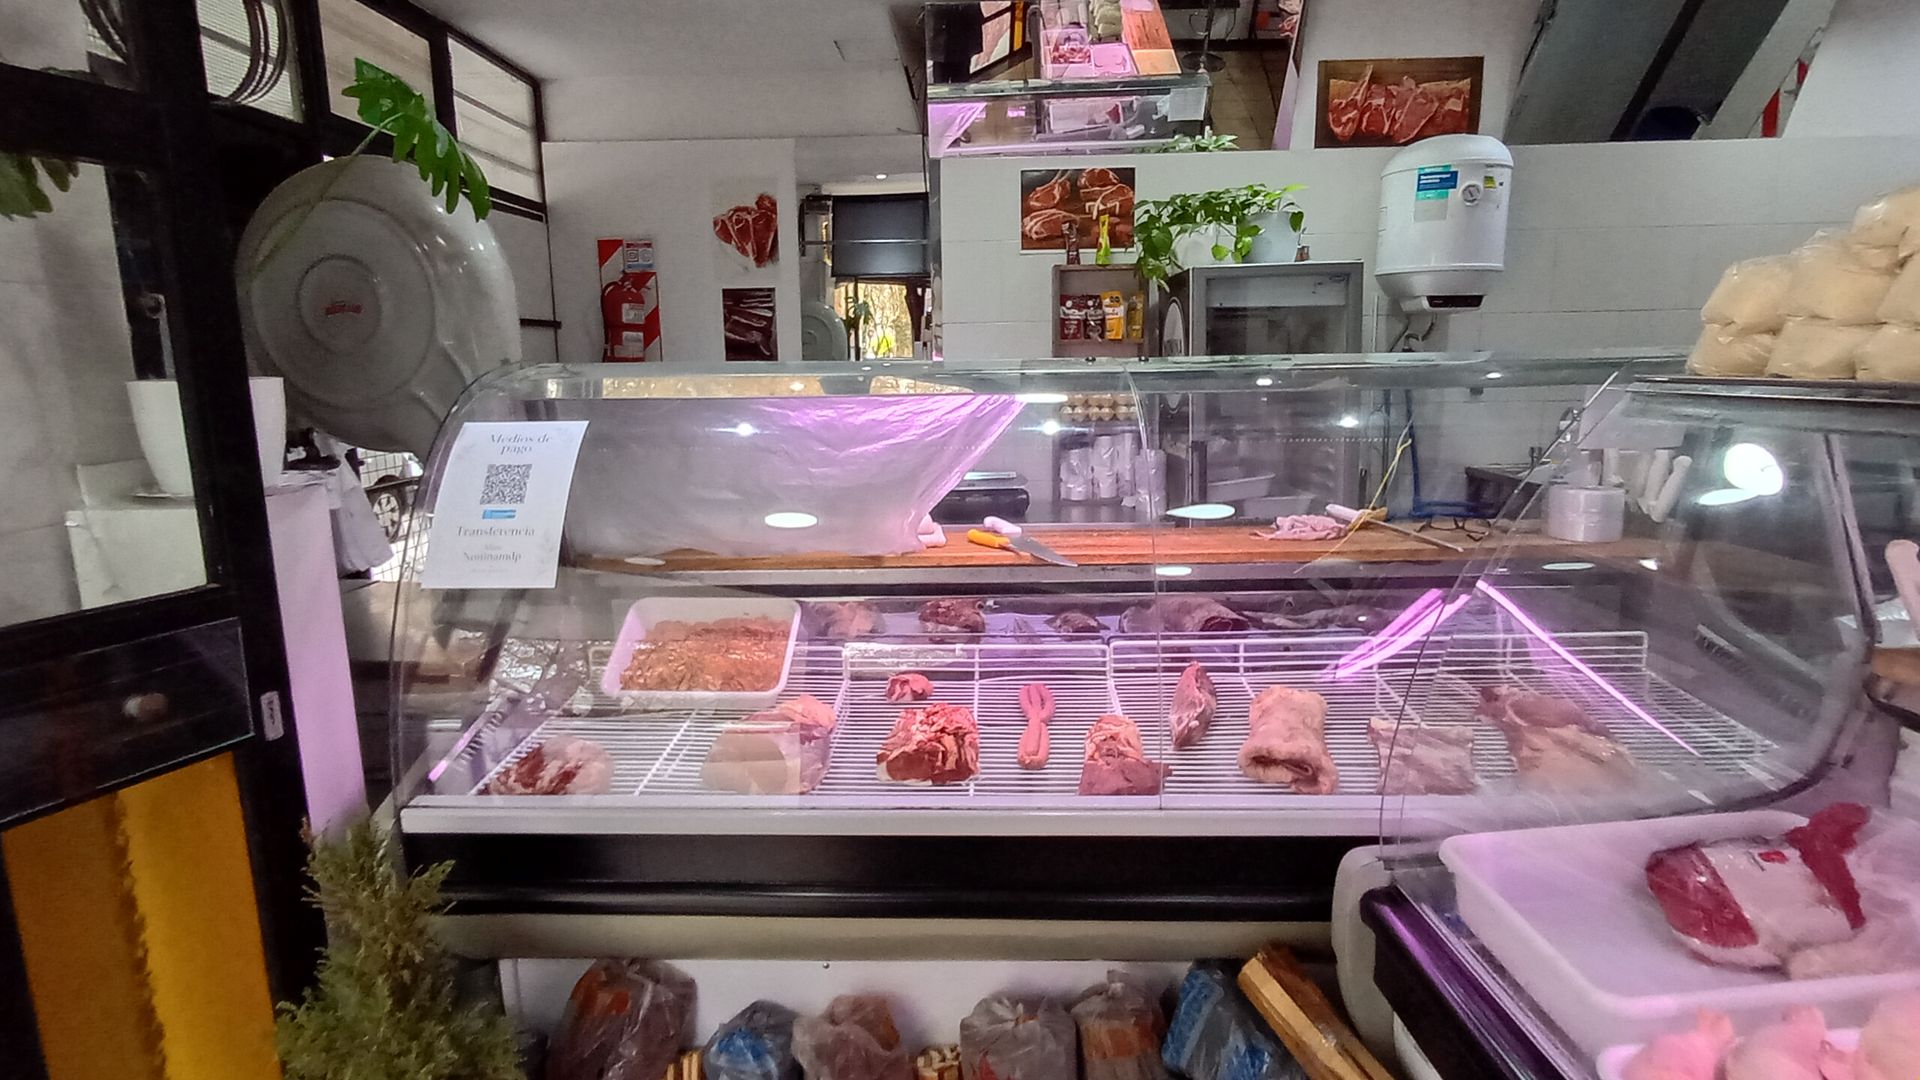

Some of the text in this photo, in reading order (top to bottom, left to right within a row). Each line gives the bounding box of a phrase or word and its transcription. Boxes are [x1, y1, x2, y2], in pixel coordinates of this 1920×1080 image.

[490, 433, 552, 443] Medios de
[500, 445, 532, 455] pago
[457, 526, 536, 537] Transferencia
